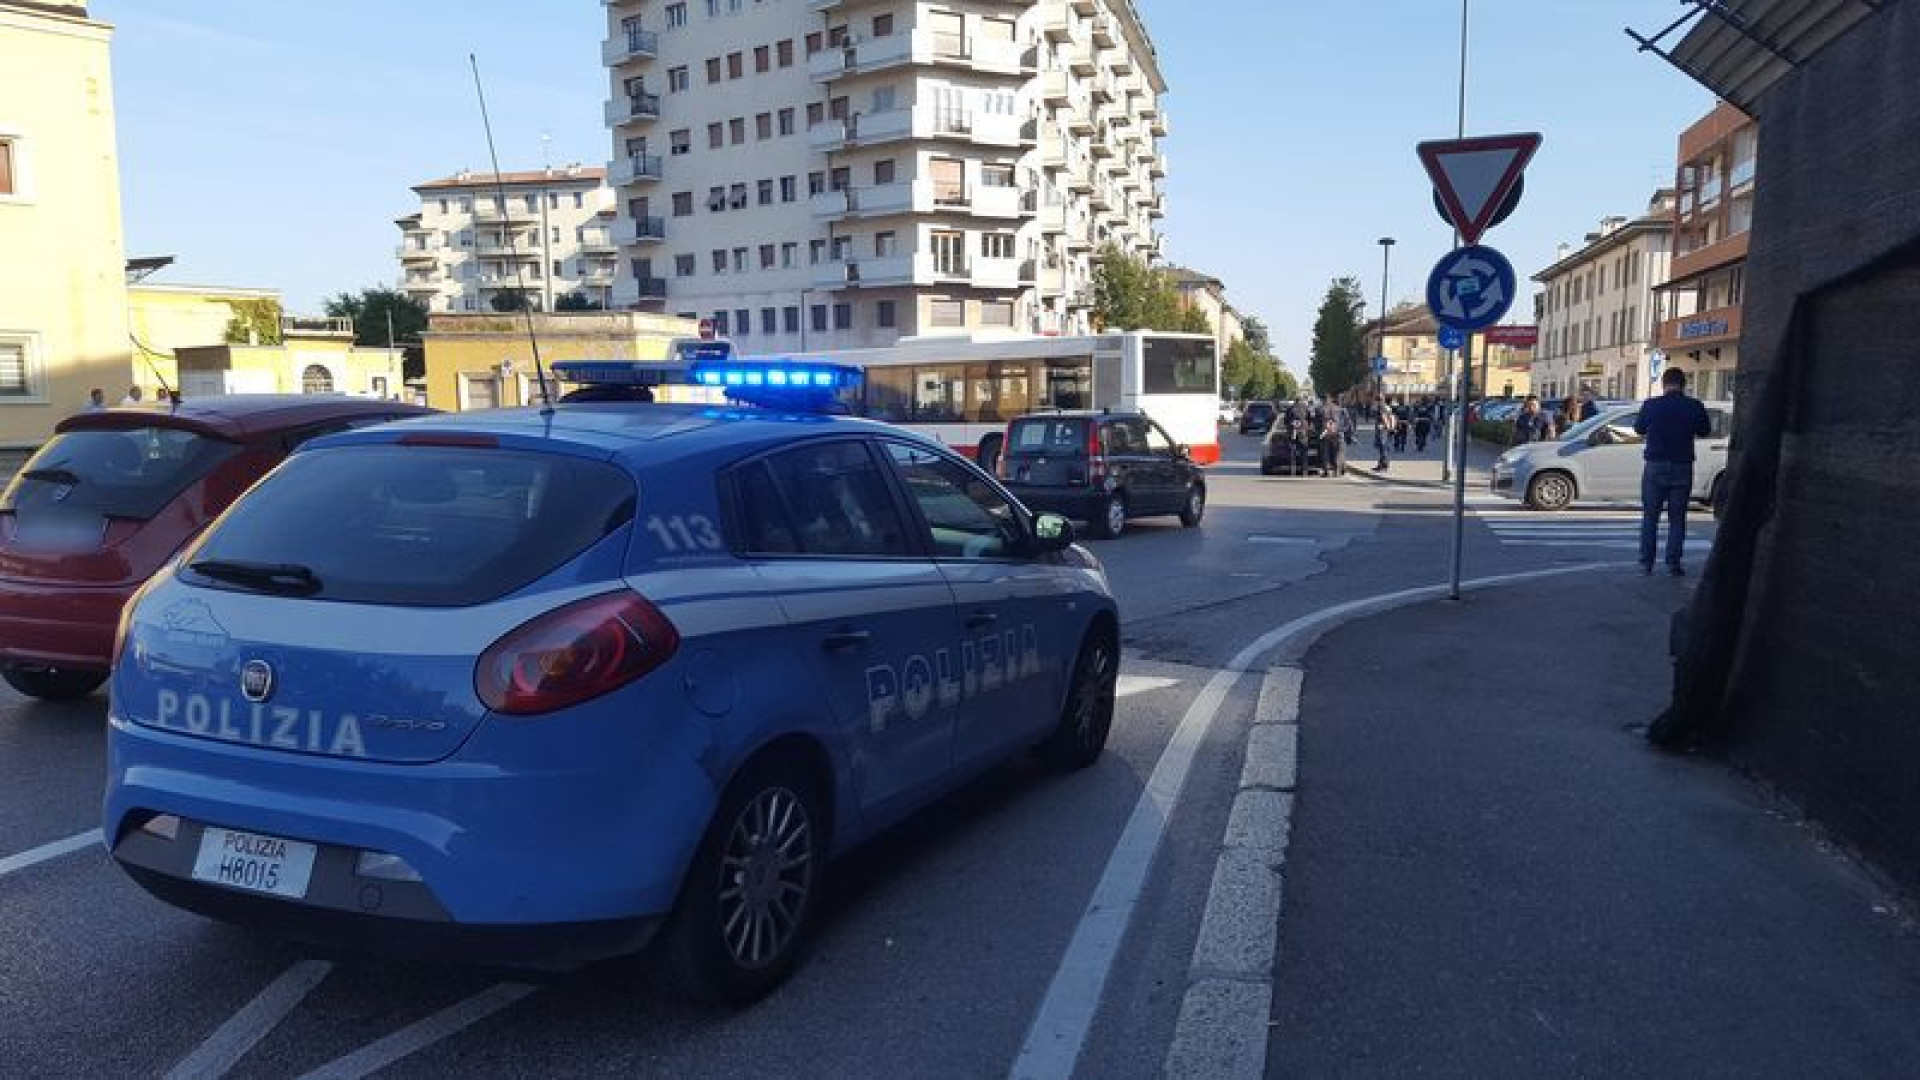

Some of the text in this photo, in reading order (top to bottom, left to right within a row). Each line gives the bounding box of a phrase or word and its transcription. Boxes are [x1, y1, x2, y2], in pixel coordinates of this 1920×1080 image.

[647, 514, 722, 552] 113
[864, 623, 1041, 734] POLIZIA
[156, 688, 367, 757] POLIZIA
[225, 831, 288, 859] POLIZIA
[218, 853, 281, 889] H8015
